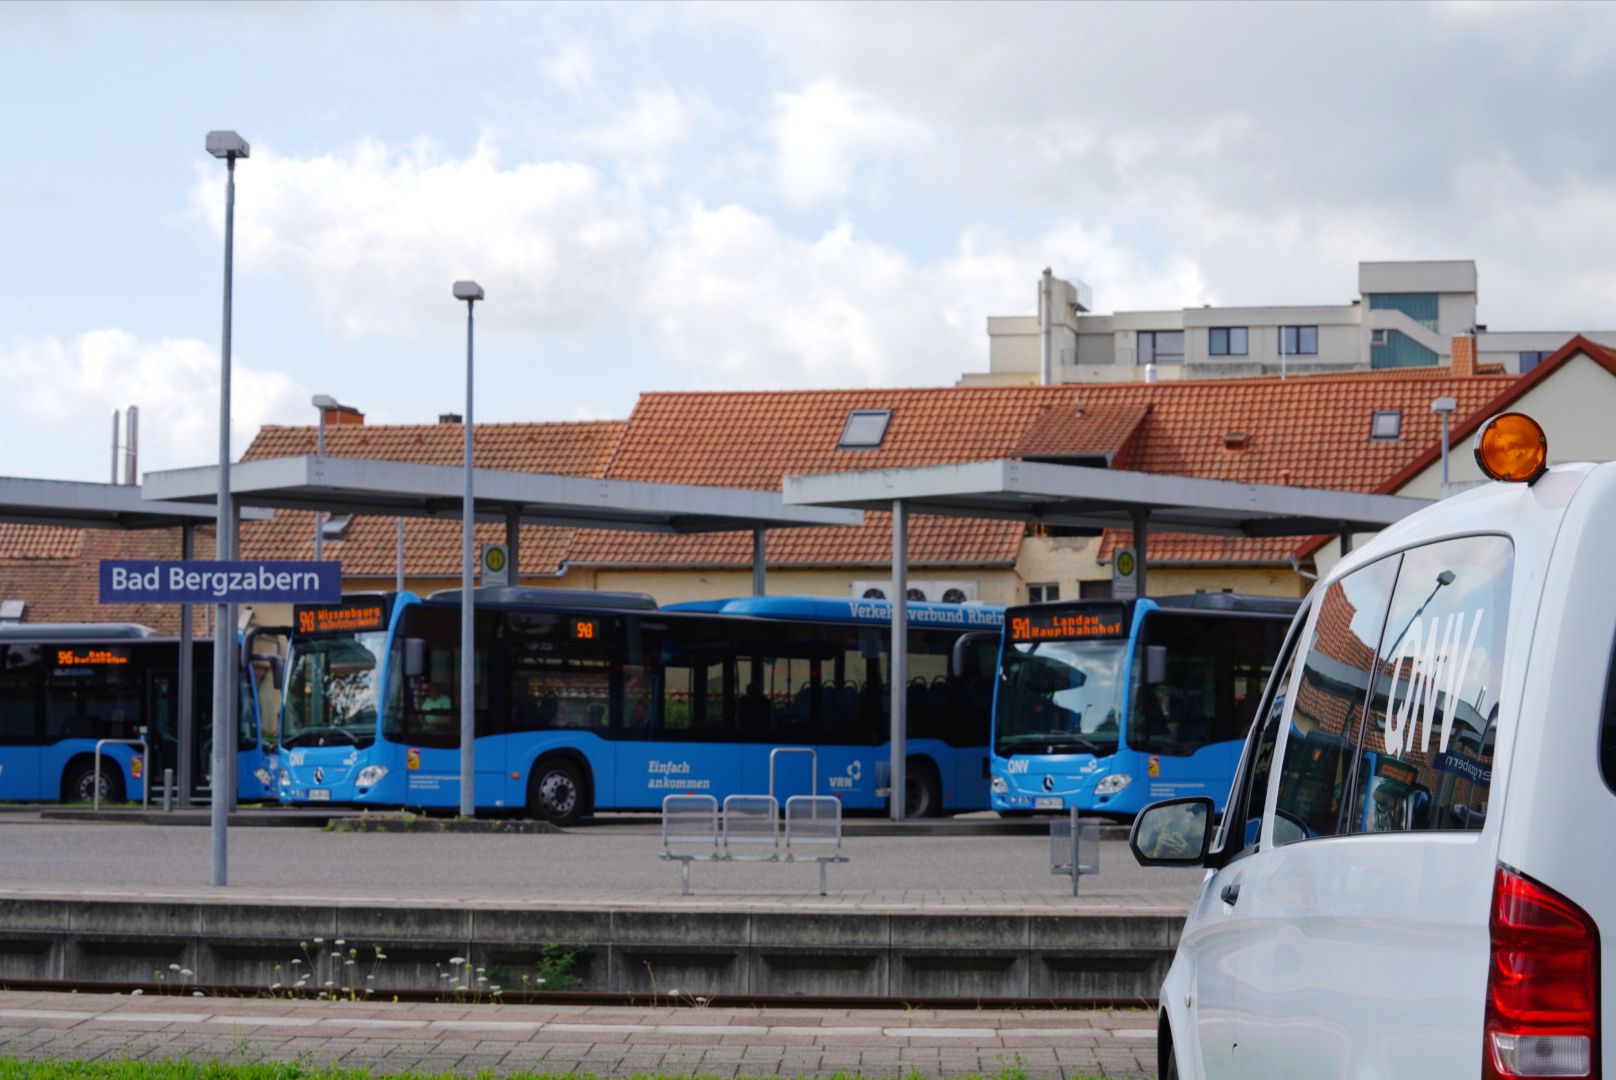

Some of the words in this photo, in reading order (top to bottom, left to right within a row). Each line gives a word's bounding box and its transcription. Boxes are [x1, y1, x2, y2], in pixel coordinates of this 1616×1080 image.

[112, 567, 160, 590] Bad
[169, 567, 320, 595] Bergzabern
[849, 603, 963, 623] Verkehverbund
[1052, 615, 1099, 626] Landau
[577, 622, 593, 638] 543
[1011, 617, 1031, 640] 541
[1031, 622, 1121, 638] Hauptbahnhof
[648, 760, 690, 776] Einfach
[648, 777, 711, 789] ankommen
[829, 777, 853, 788] VRN
